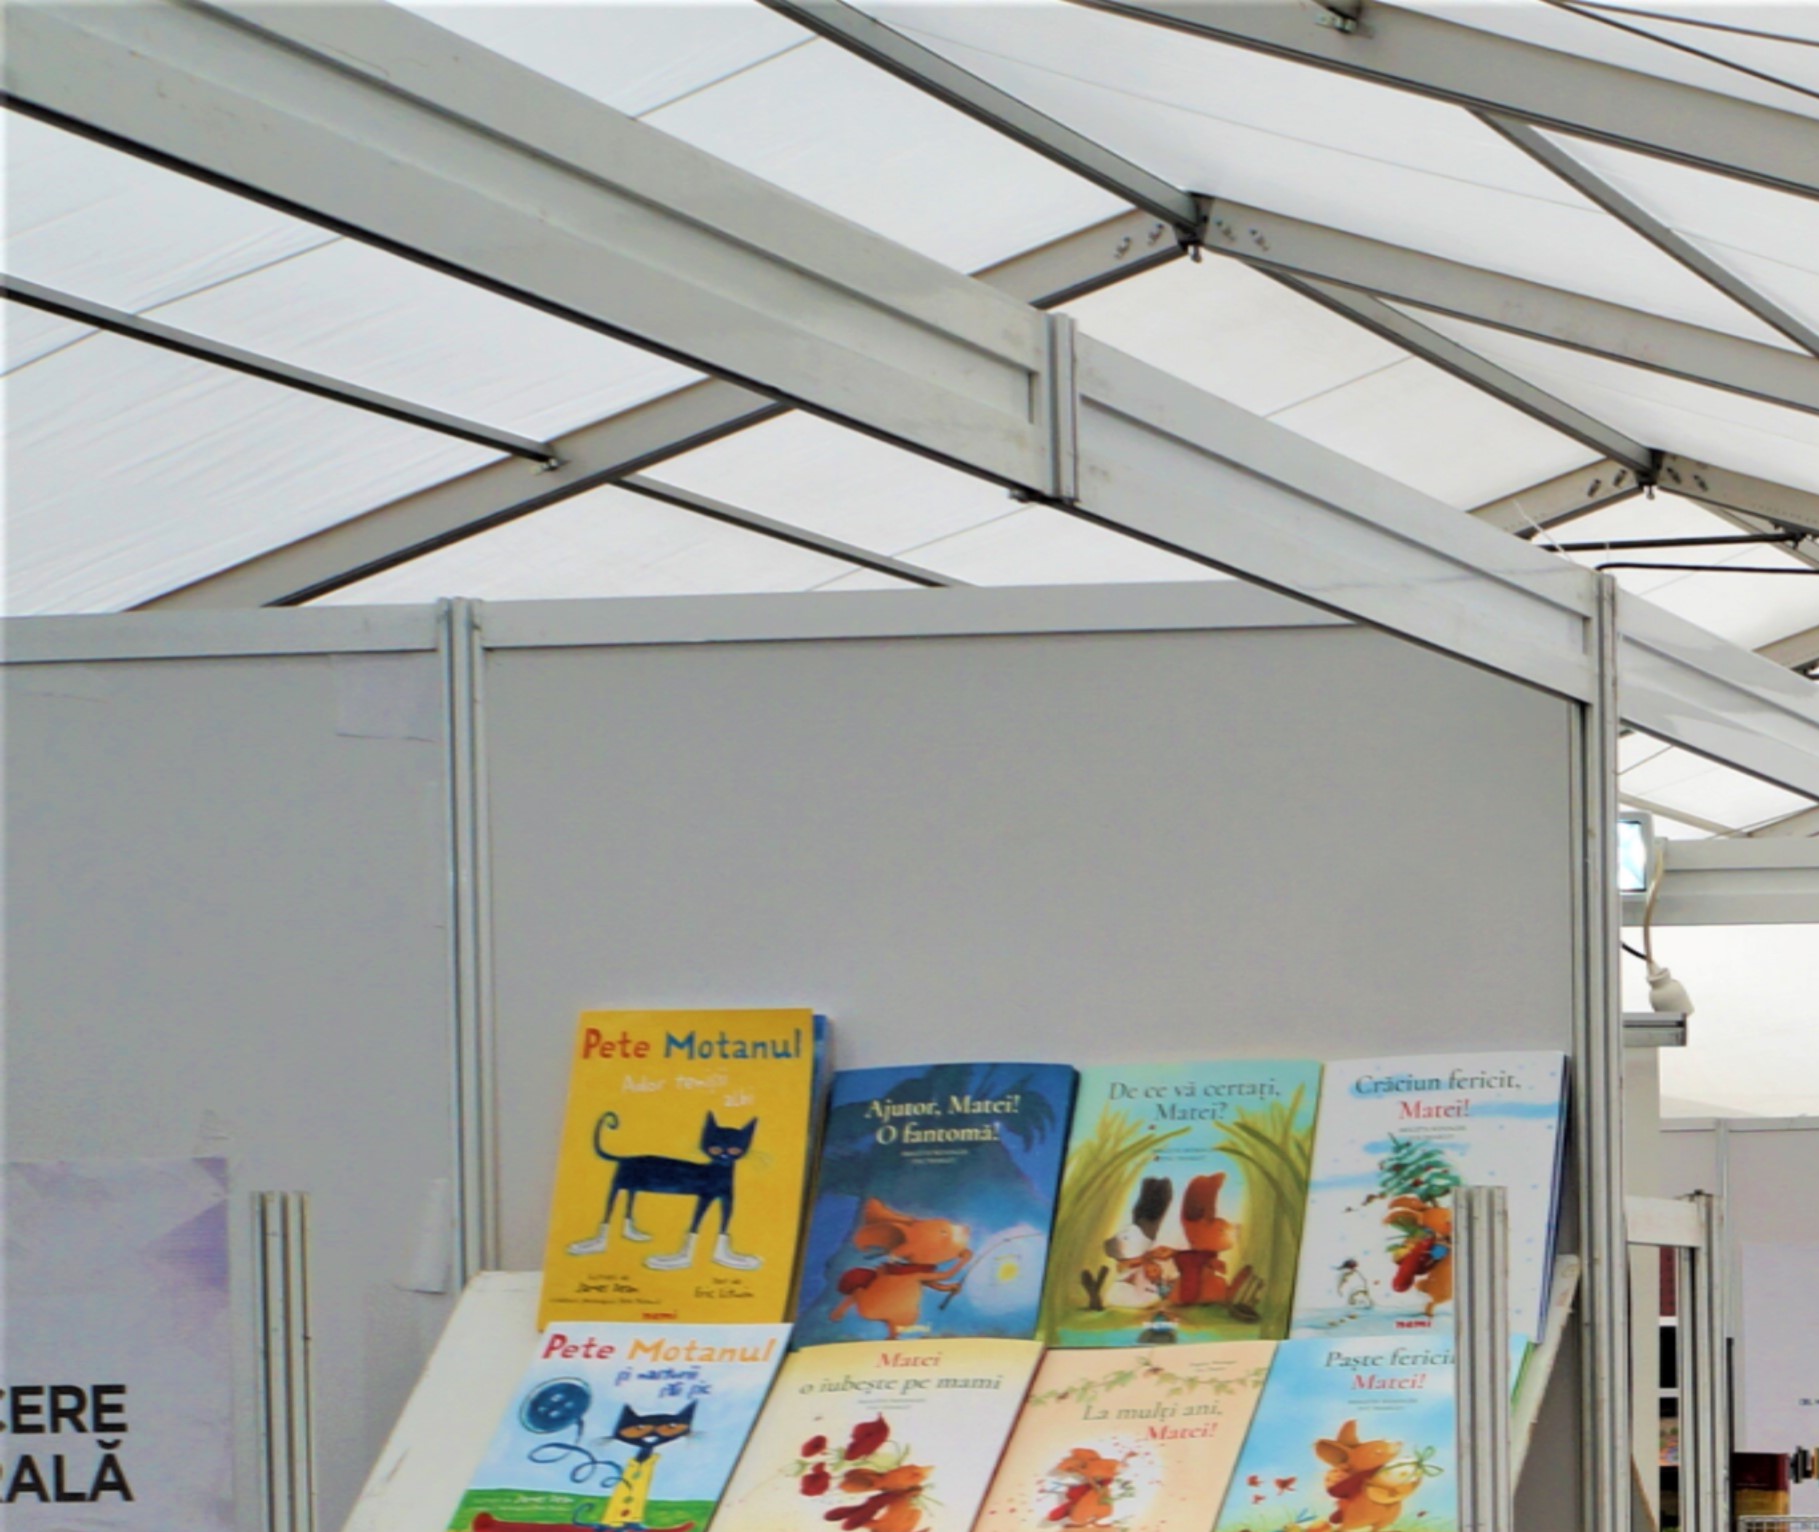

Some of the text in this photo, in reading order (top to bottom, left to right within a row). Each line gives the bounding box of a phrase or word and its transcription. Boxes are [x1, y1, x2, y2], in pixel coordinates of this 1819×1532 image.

[582, 1028, 803, 1061] Pete Motanul
[1109, 1082, 1139, 1100] De
[1144, 1087, 1168, 1098] ce
[1355, 1067, 1522, 1095] Crăciun fericit,
[864, 1094, 1021, 1123] Ajutor, Matei!
[1154, 1102, 1228, 1121] Matei?
[1399, 1099, 1470, 1120] Matei!
[875, 1121, 1000, 1145] O fantomă!
[541, 1333, 778, 1363] Pete Motanul
[875, 1351, 943, 1369] Matei
[1325, 1350, 1389, 1371] Paște
[799, 1375, 1004, 1395] o iubește pe mami
[1351, 1372, 1427, 1391] Matei!
[0, 1384, 129, 1434] ERE
[1082, 1404, 1118, 1422] La
[1180, 1400, 1223, 1419] ani,
[1144, 1421, 1218, 1442] Matei!
[0, 1439, 135, 1502] ALĂ
